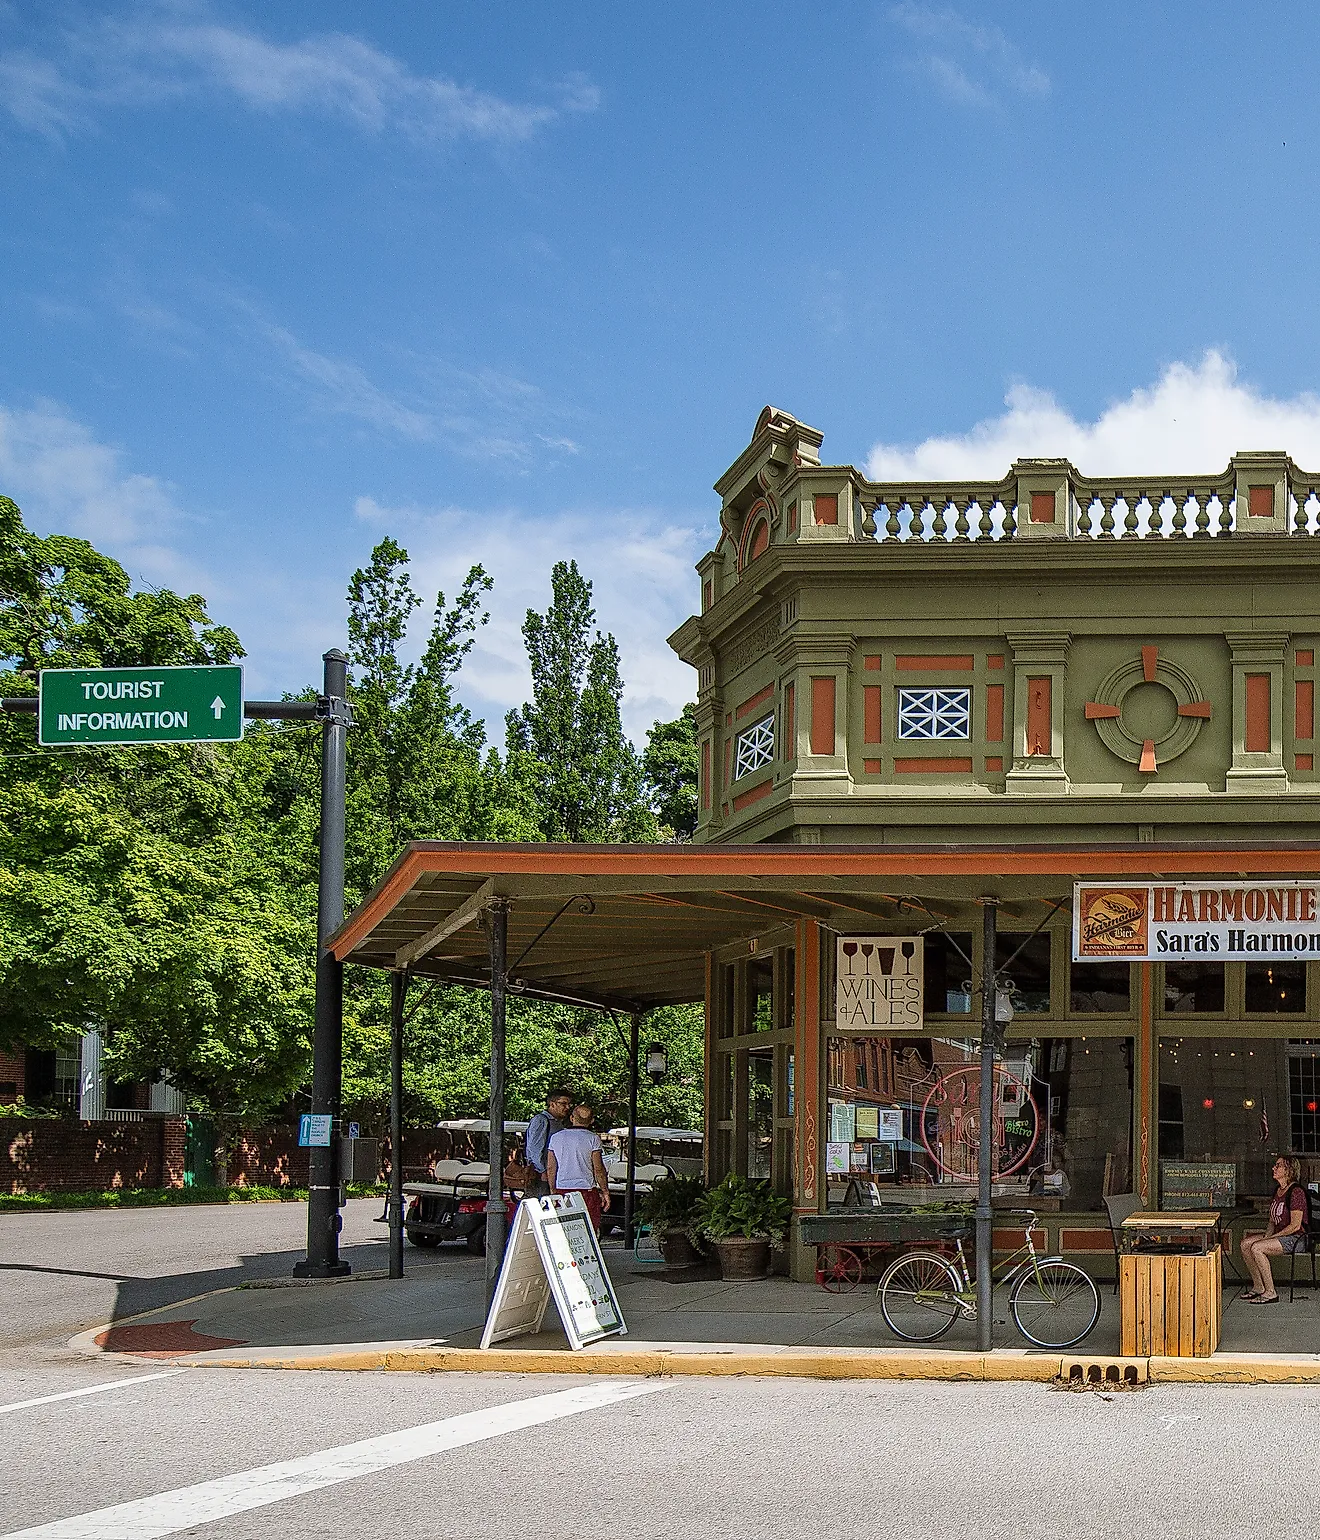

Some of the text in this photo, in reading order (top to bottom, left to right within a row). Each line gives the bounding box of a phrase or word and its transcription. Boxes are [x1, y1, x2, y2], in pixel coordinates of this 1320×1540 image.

[81, 681, 165, 700] TOURIST
[57, 711, 188, 731] INFORMATION
[1152, 887, 1317, 922] HARMONIE
[1114, 927, 1134, 938] Bier
[1156, 929, 1220, 953] Sara's
[840, 978, 920, 1000] WINES
[850, 1000, 920, 1025] ALES
[1005, 1122, 1032, 1137] Bistro
